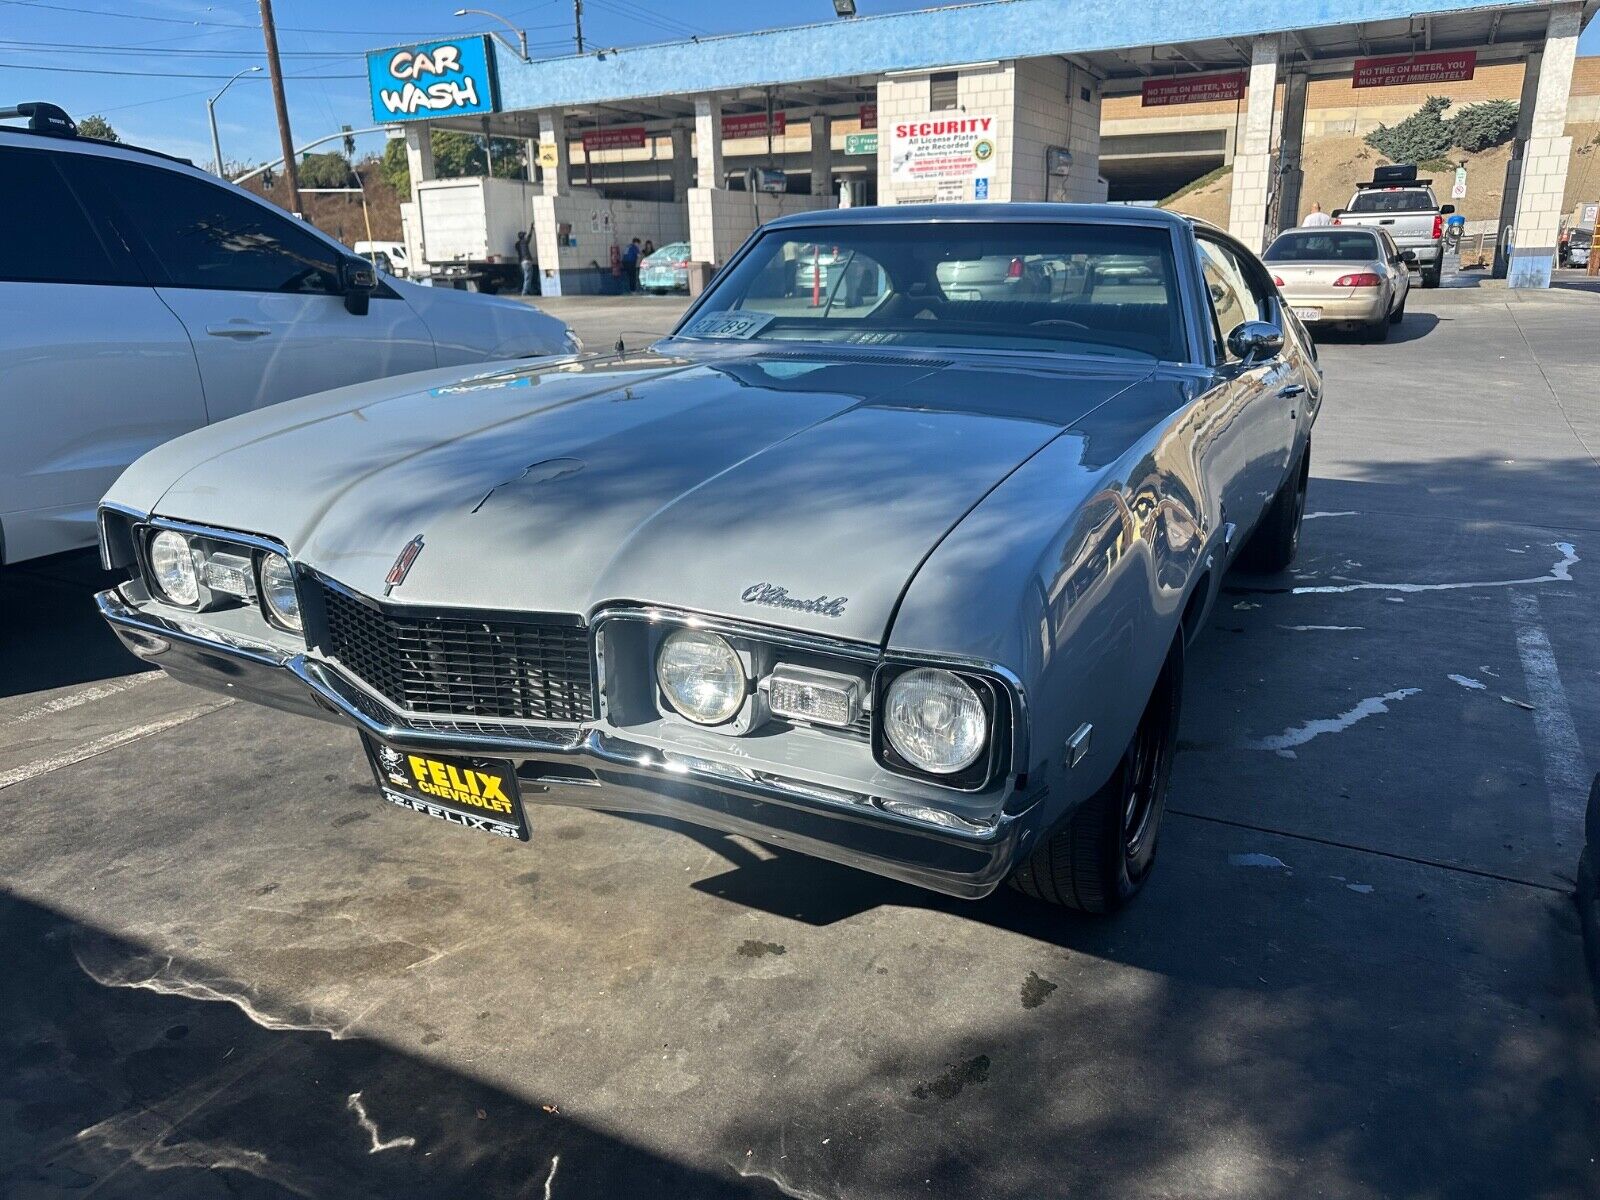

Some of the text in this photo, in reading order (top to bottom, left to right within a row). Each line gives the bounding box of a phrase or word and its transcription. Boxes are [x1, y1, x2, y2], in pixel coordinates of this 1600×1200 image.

[390, 45, 460, 78] CAR
[1359, 61, 1466, 76] NO TIME ON METER, YOU
[1160, 86, 1178, 94] TIME
[1222, 81, 1238, 89] YOU
[1359, 71, 1467, 85] MUST EXIT IMMEDIATELY
[380, 77, 478, 113] WASH
[1146, 90, 1239, 105] MUST EXIT IMMEDIATELY
[896, 118, 991, 138] SECURITY
[921, 136, 952, 144] License
[932, 141, 969, 150] Recorded
[741, 582, 848, 618] Oldsmobile
[408, 754, 511, 803] FELIX
[418, 780, 512, 814] CHEVROLET
[411, 800, 488, 832] FELIX
